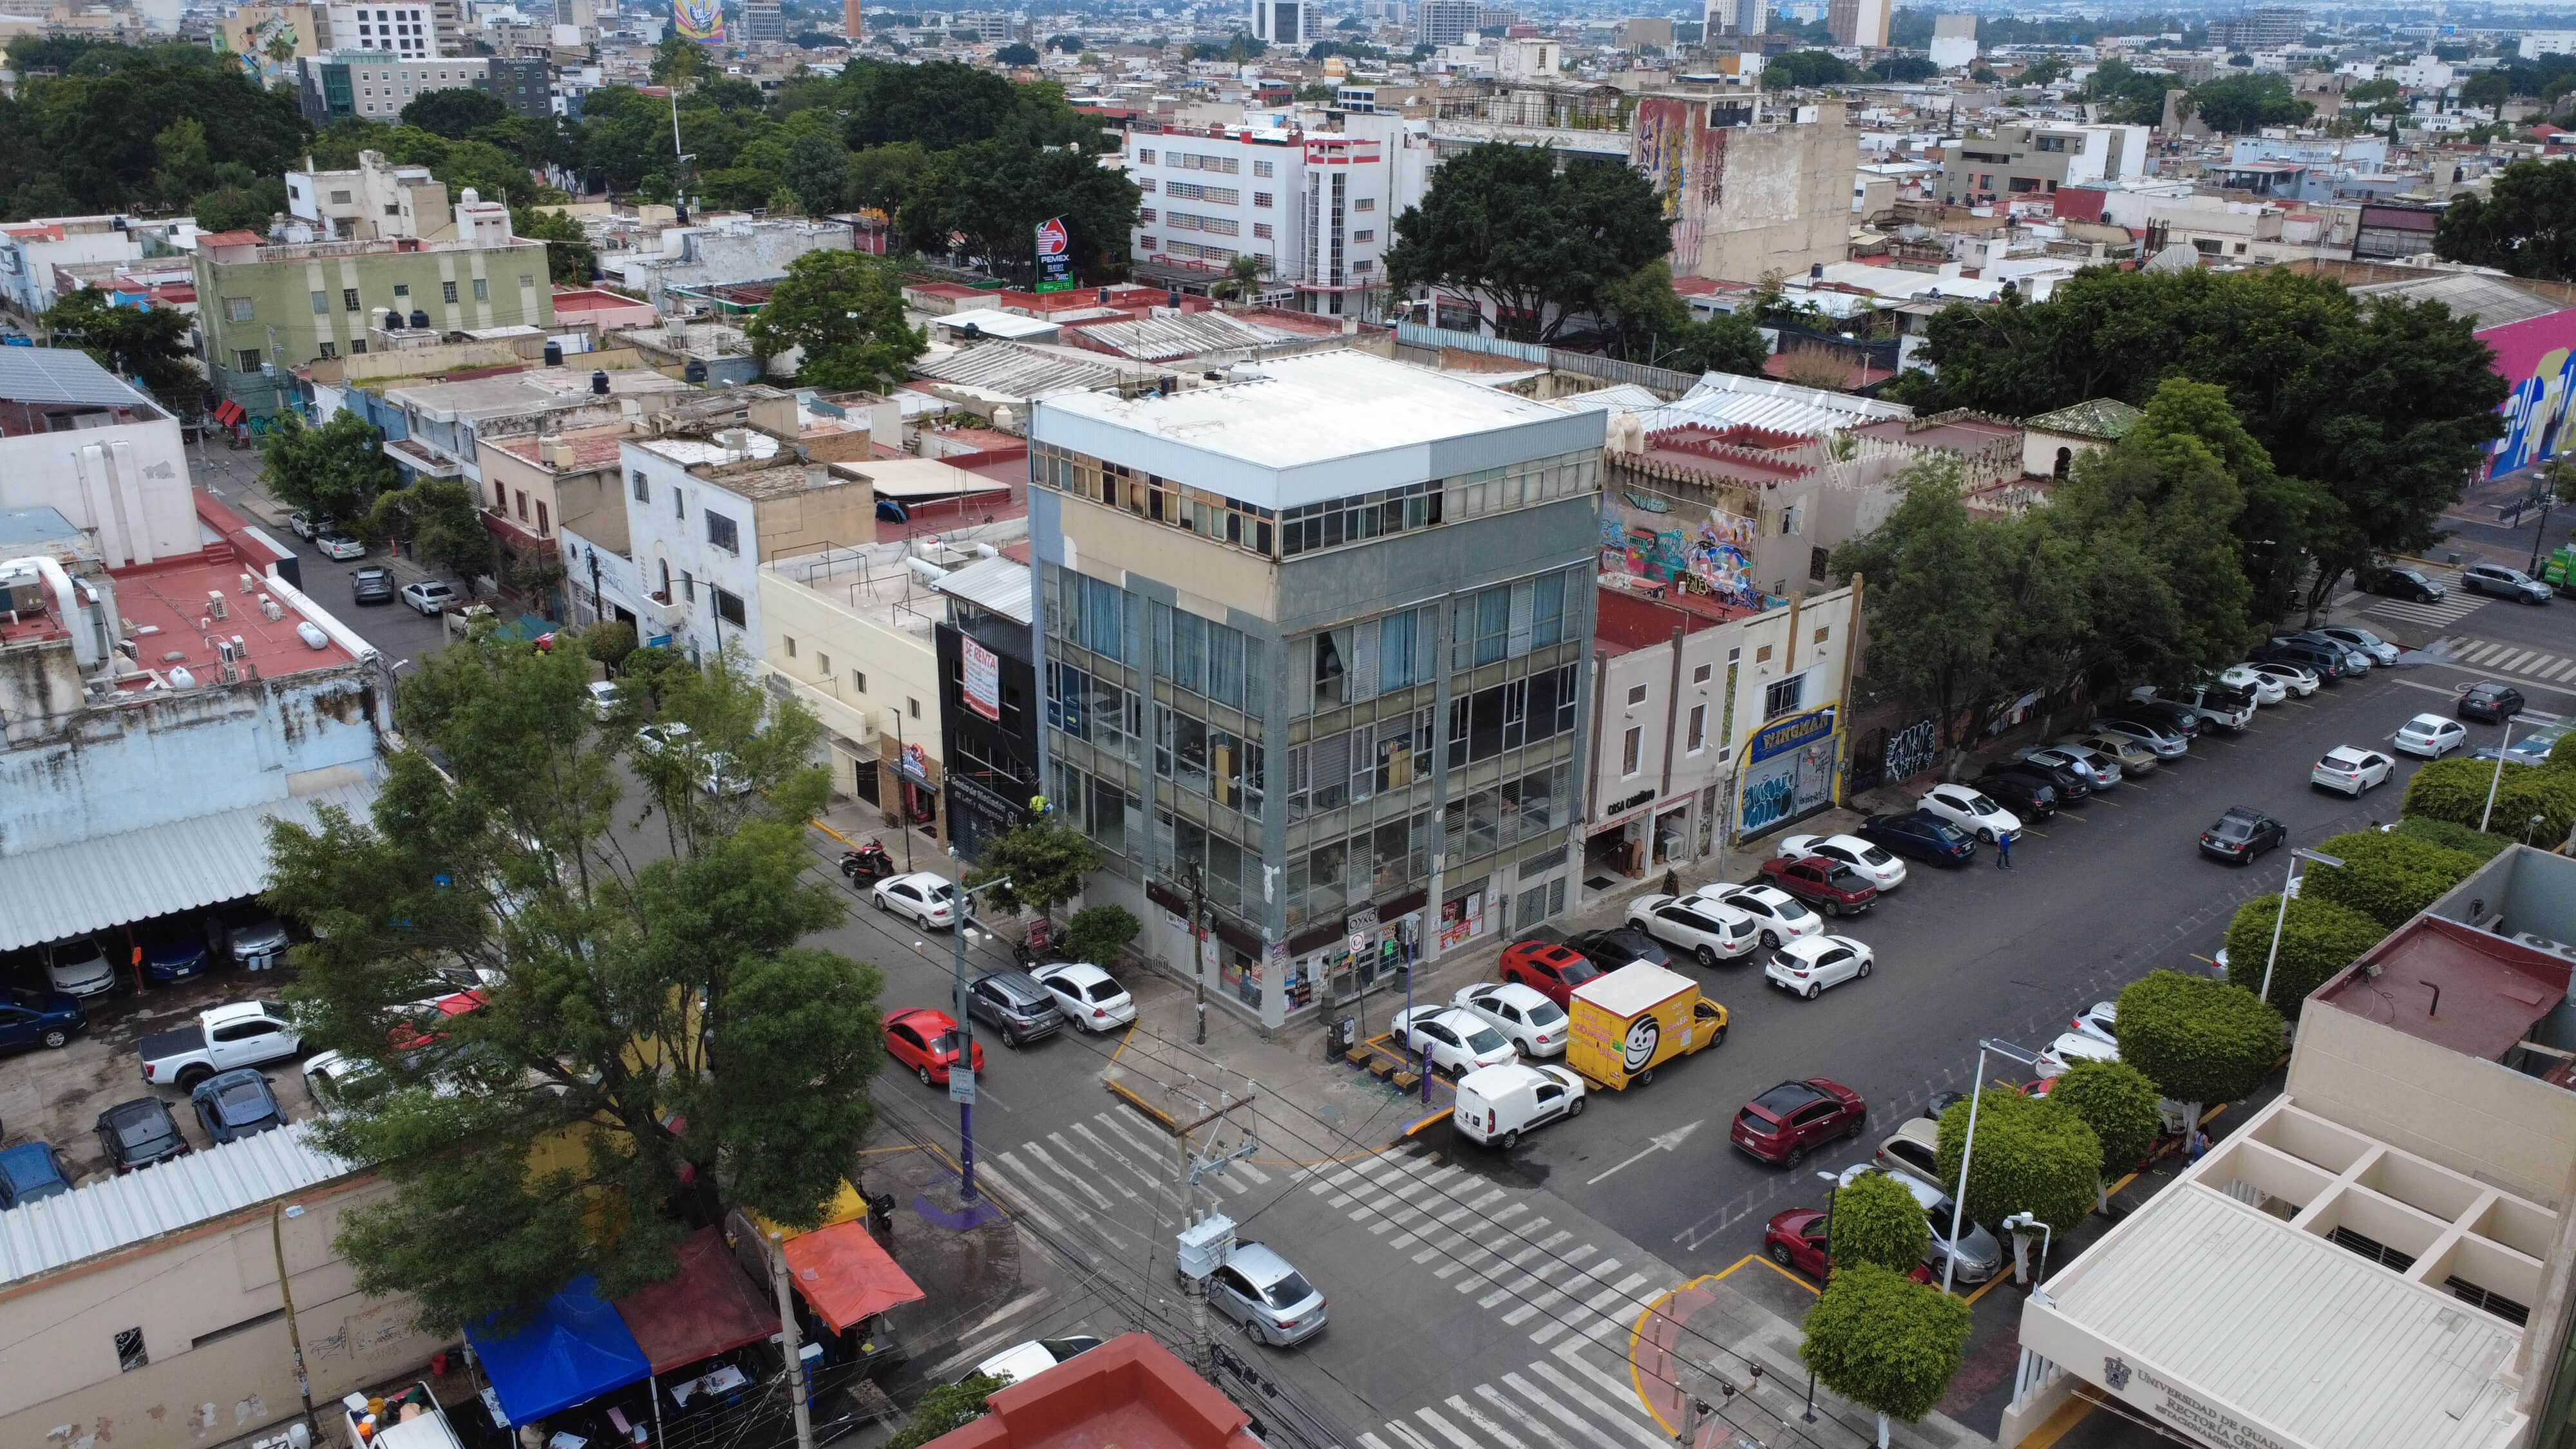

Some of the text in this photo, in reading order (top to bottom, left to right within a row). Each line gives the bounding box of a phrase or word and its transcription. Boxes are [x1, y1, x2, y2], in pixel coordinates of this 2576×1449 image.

[1041, 254, 1069, 263] PEMEX
[974, 647, 996, 670] RENTA
[1763, 715, 1828, 748] WINGMAN
[1607, 800, 1625, 816] CASA
[1349, 912, 1376, 930] OXXO
[2137, 1368, 2284, 1449] UNIVERSIDAD DE GUAD
[2166, 1396, 2230, 1440] RECTORÍA
